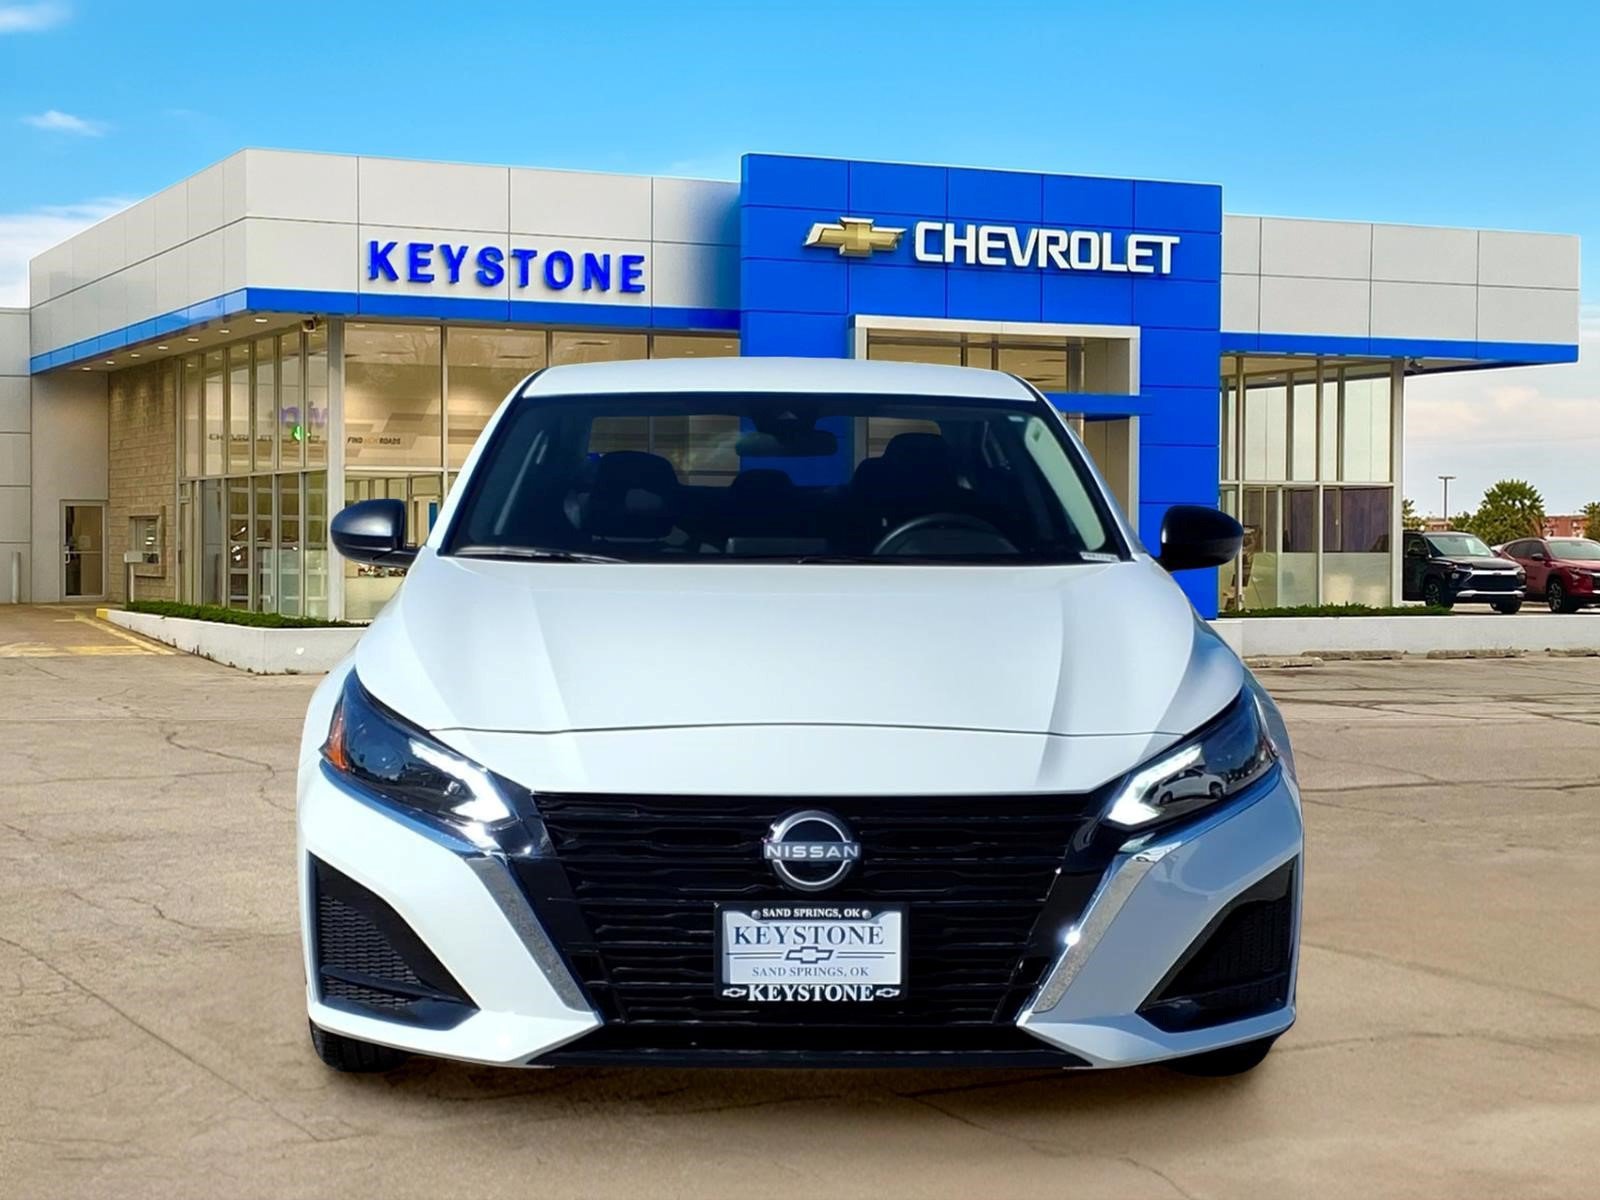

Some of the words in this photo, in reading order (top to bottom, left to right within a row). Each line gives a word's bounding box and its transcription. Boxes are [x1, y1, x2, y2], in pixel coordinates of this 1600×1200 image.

[914, 220, 1181, 276] CHEVROLET
[368, 240, 646, 293] KEYSTONE
[766, 844, 859, 859] NISSAN
[762, 908, 791, 918] SAND
[793, 908, 842, 919] SPRINGS,
[844, 908, 860, 918] OK
[733, 925, 884, 946] KEYSTONE
[752, 966, 786, 977] SAND
[789, 966, 847, 978] SPRINGS,
[850, 966, 869, 977] OK
[748, 984, 875, 1002] KEYSTONE
